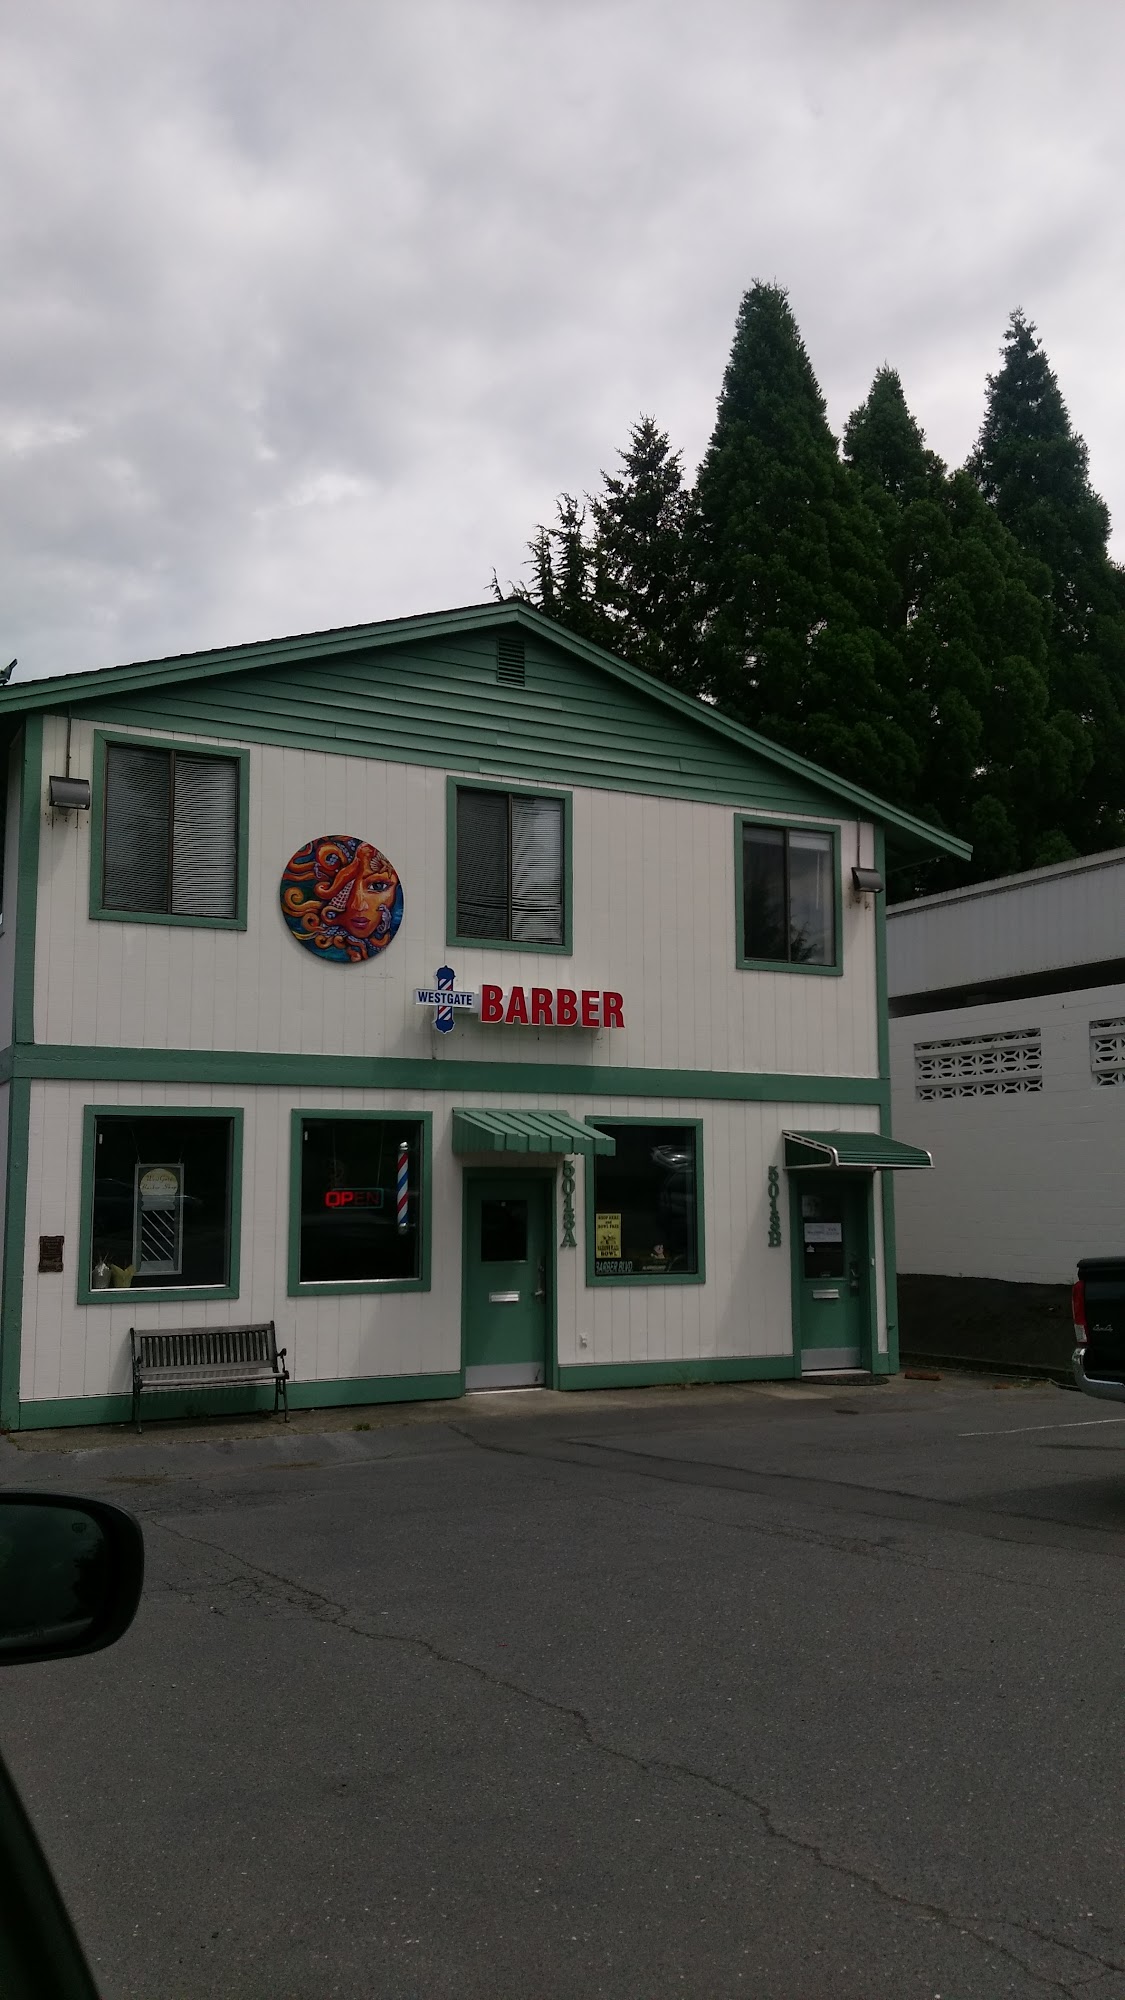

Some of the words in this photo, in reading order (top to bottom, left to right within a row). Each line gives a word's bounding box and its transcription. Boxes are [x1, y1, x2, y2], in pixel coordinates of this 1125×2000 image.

[418, 991, 473, 1006] WESTGATE
[481, 984, 625, 1028] BARBER
[324, 1191, 381, 1207] OPEN
